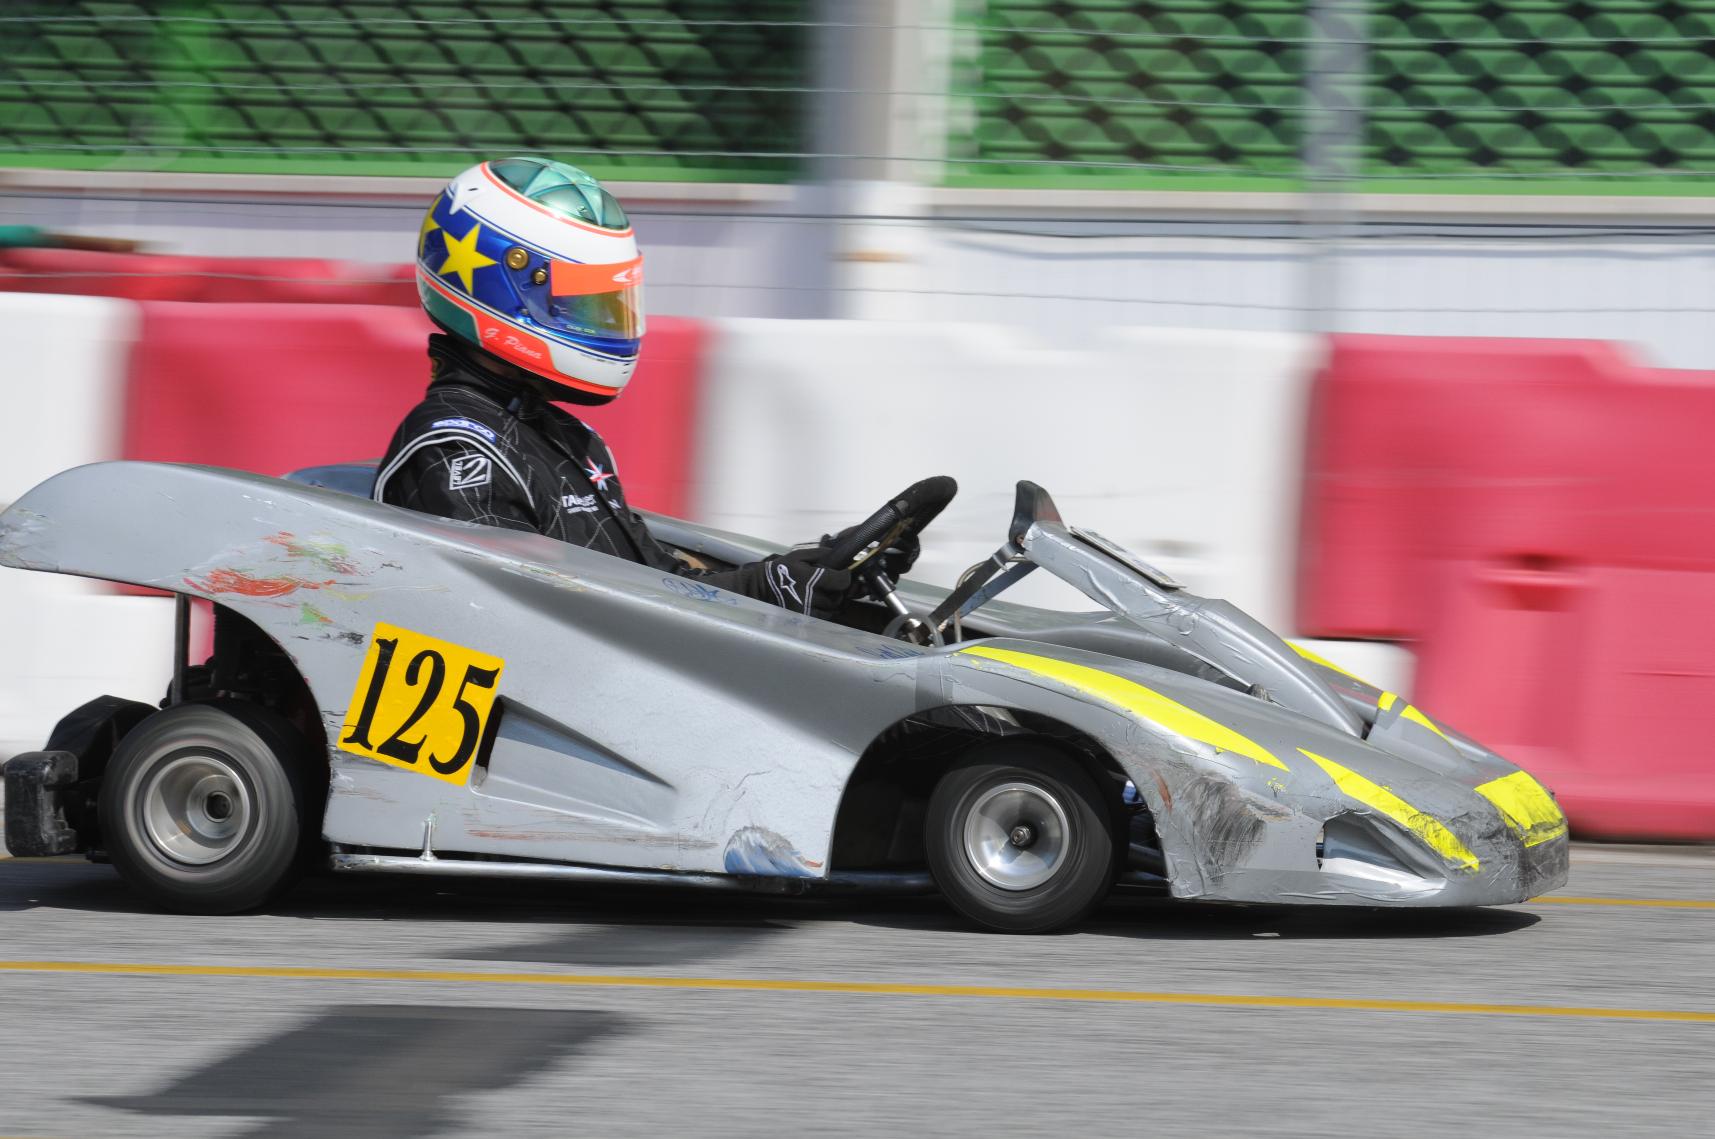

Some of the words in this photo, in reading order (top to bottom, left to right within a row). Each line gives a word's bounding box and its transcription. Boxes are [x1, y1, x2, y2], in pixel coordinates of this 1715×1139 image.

[452, 460, 463, 486] LEVEL
[461, 457, 487, 484] 2
[343, 638, 500, 775] 125
